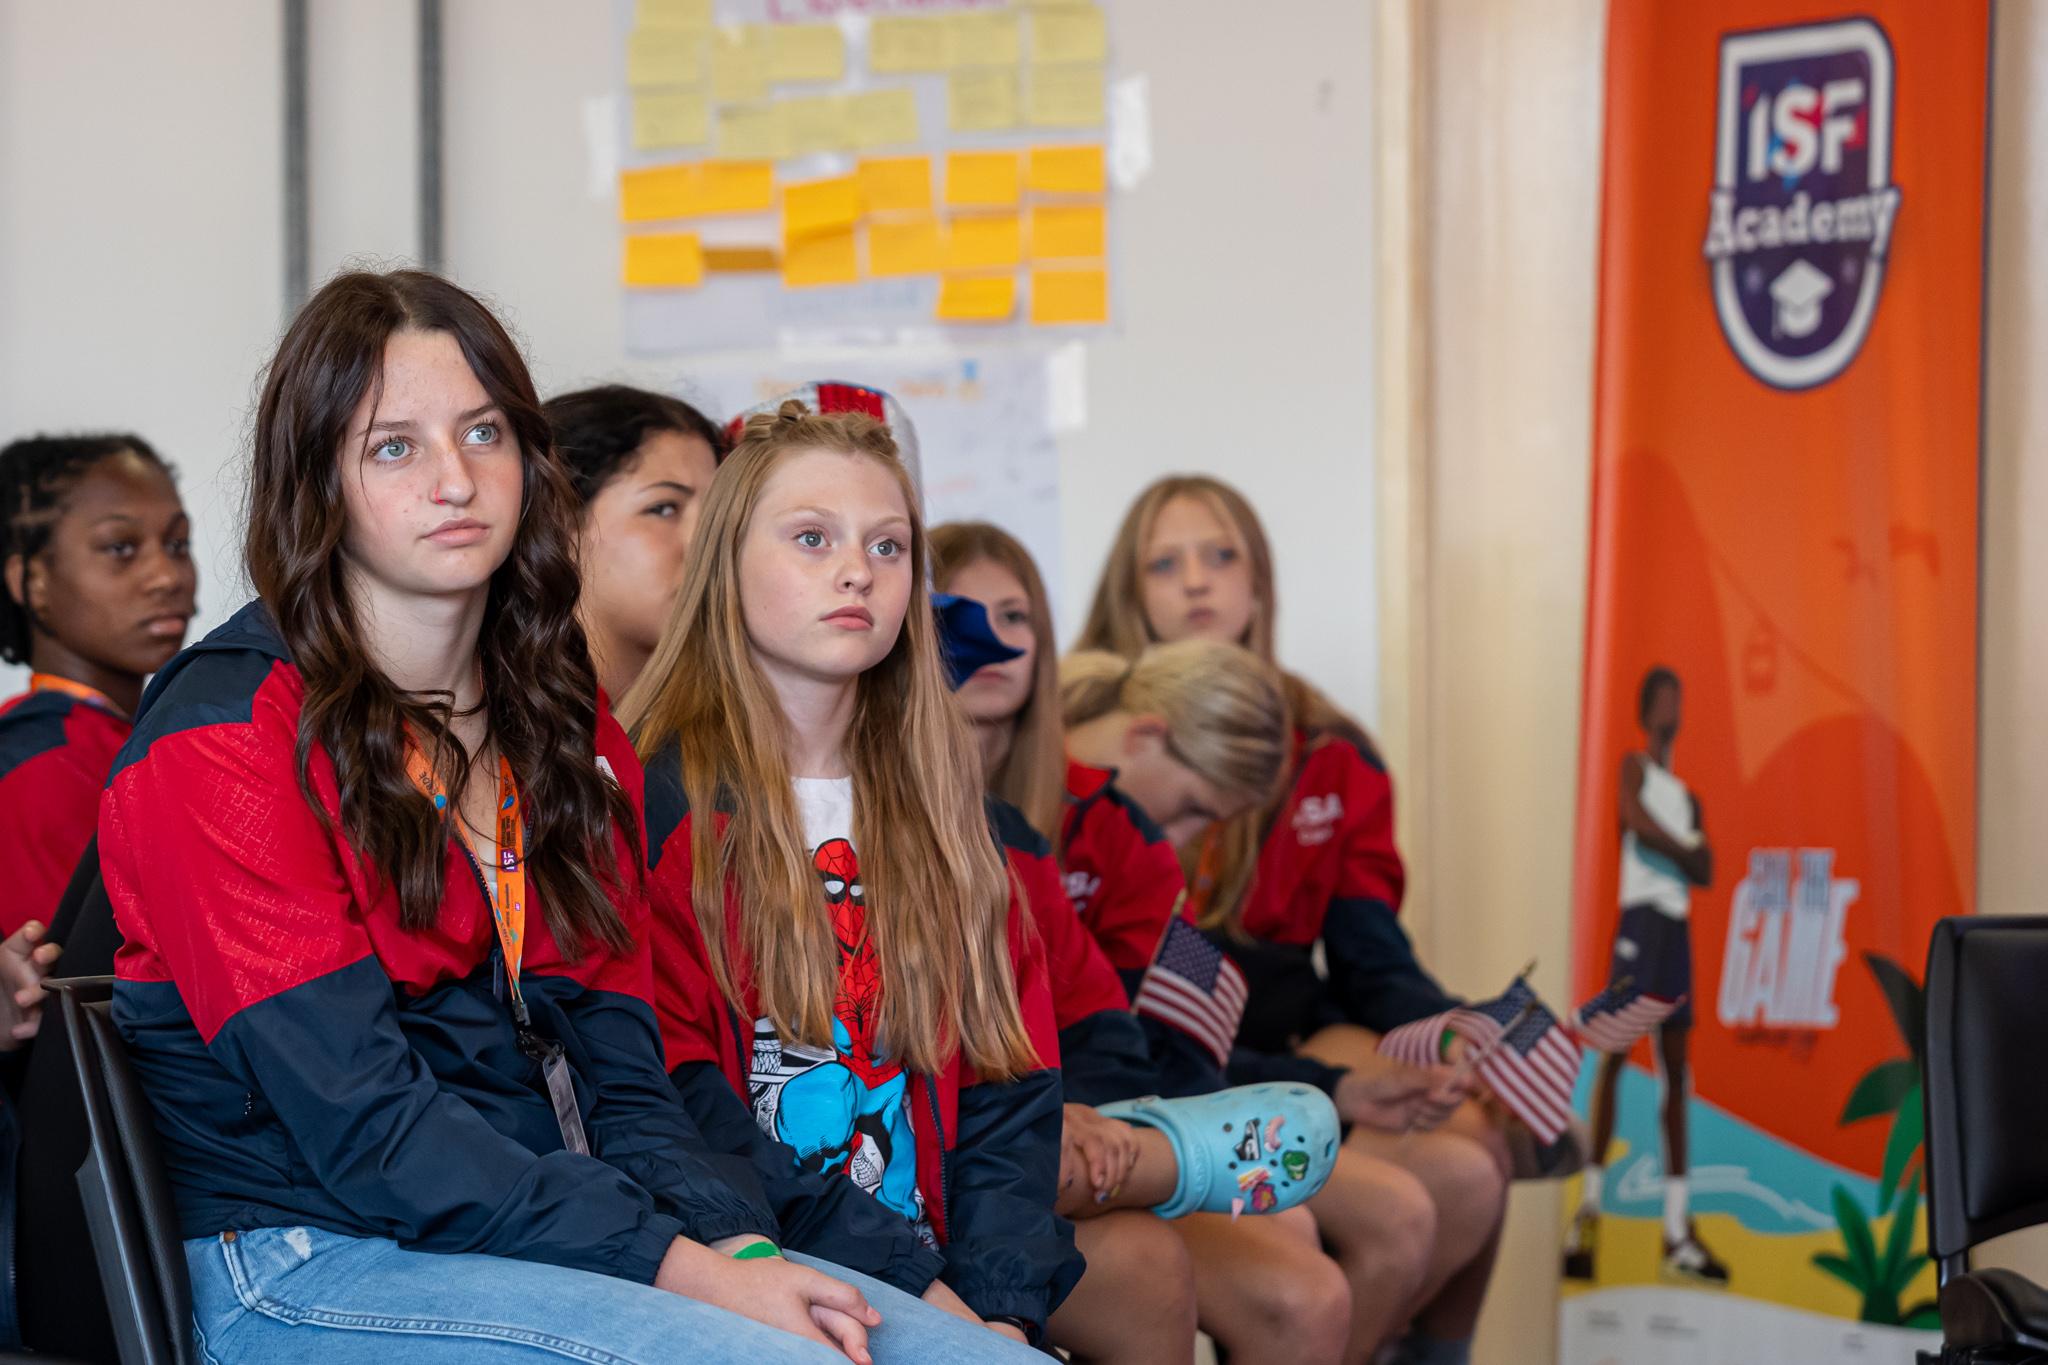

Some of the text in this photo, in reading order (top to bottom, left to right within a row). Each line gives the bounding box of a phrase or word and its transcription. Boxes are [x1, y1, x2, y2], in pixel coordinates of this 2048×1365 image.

[1747, 78, 1864, 182] ISF
[1704, 187, 1901, 257] Academy
[503, 851, 515, 871] ISF
[1718, 878, 1860, 1029] GAME
